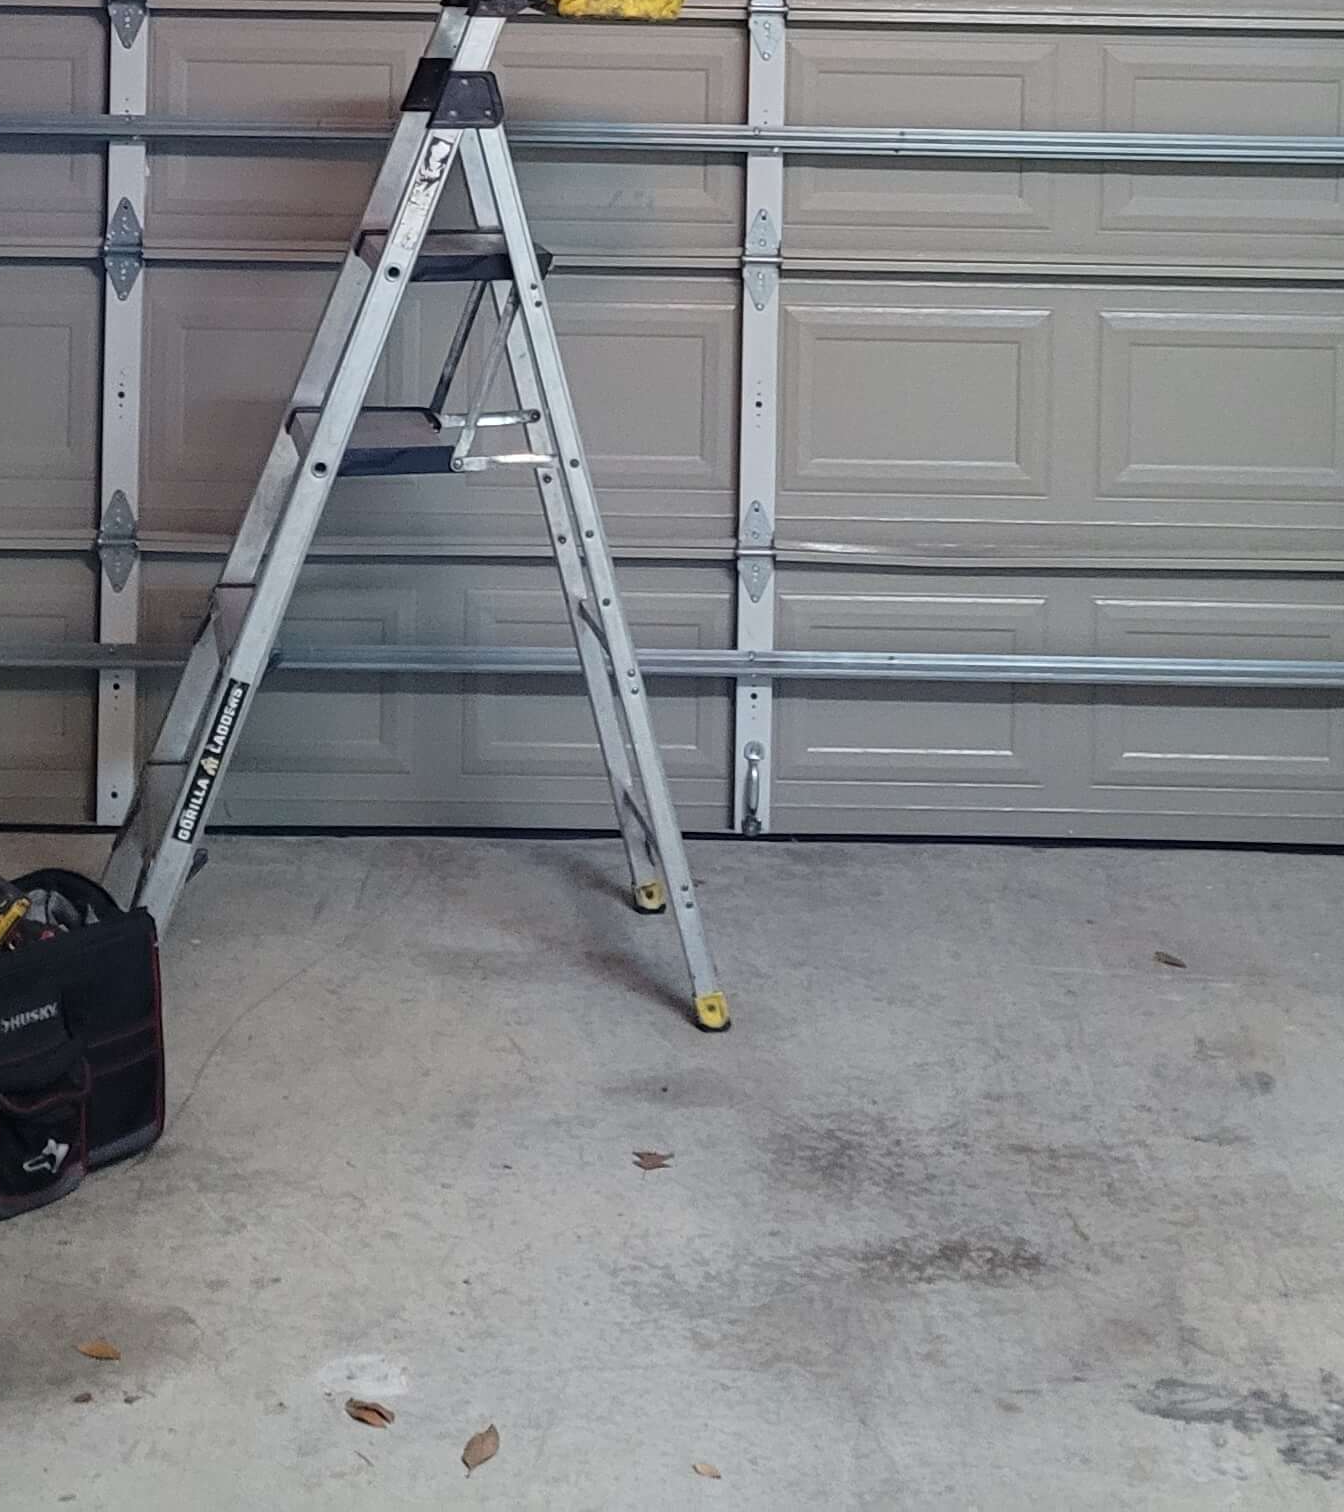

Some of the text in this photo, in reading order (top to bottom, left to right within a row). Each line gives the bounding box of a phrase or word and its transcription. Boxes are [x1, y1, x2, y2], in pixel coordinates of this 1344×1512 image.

[177, 686, 243, 841] GORILLA LADDERS
[10, 1001, 58, 1031] HUSKY
